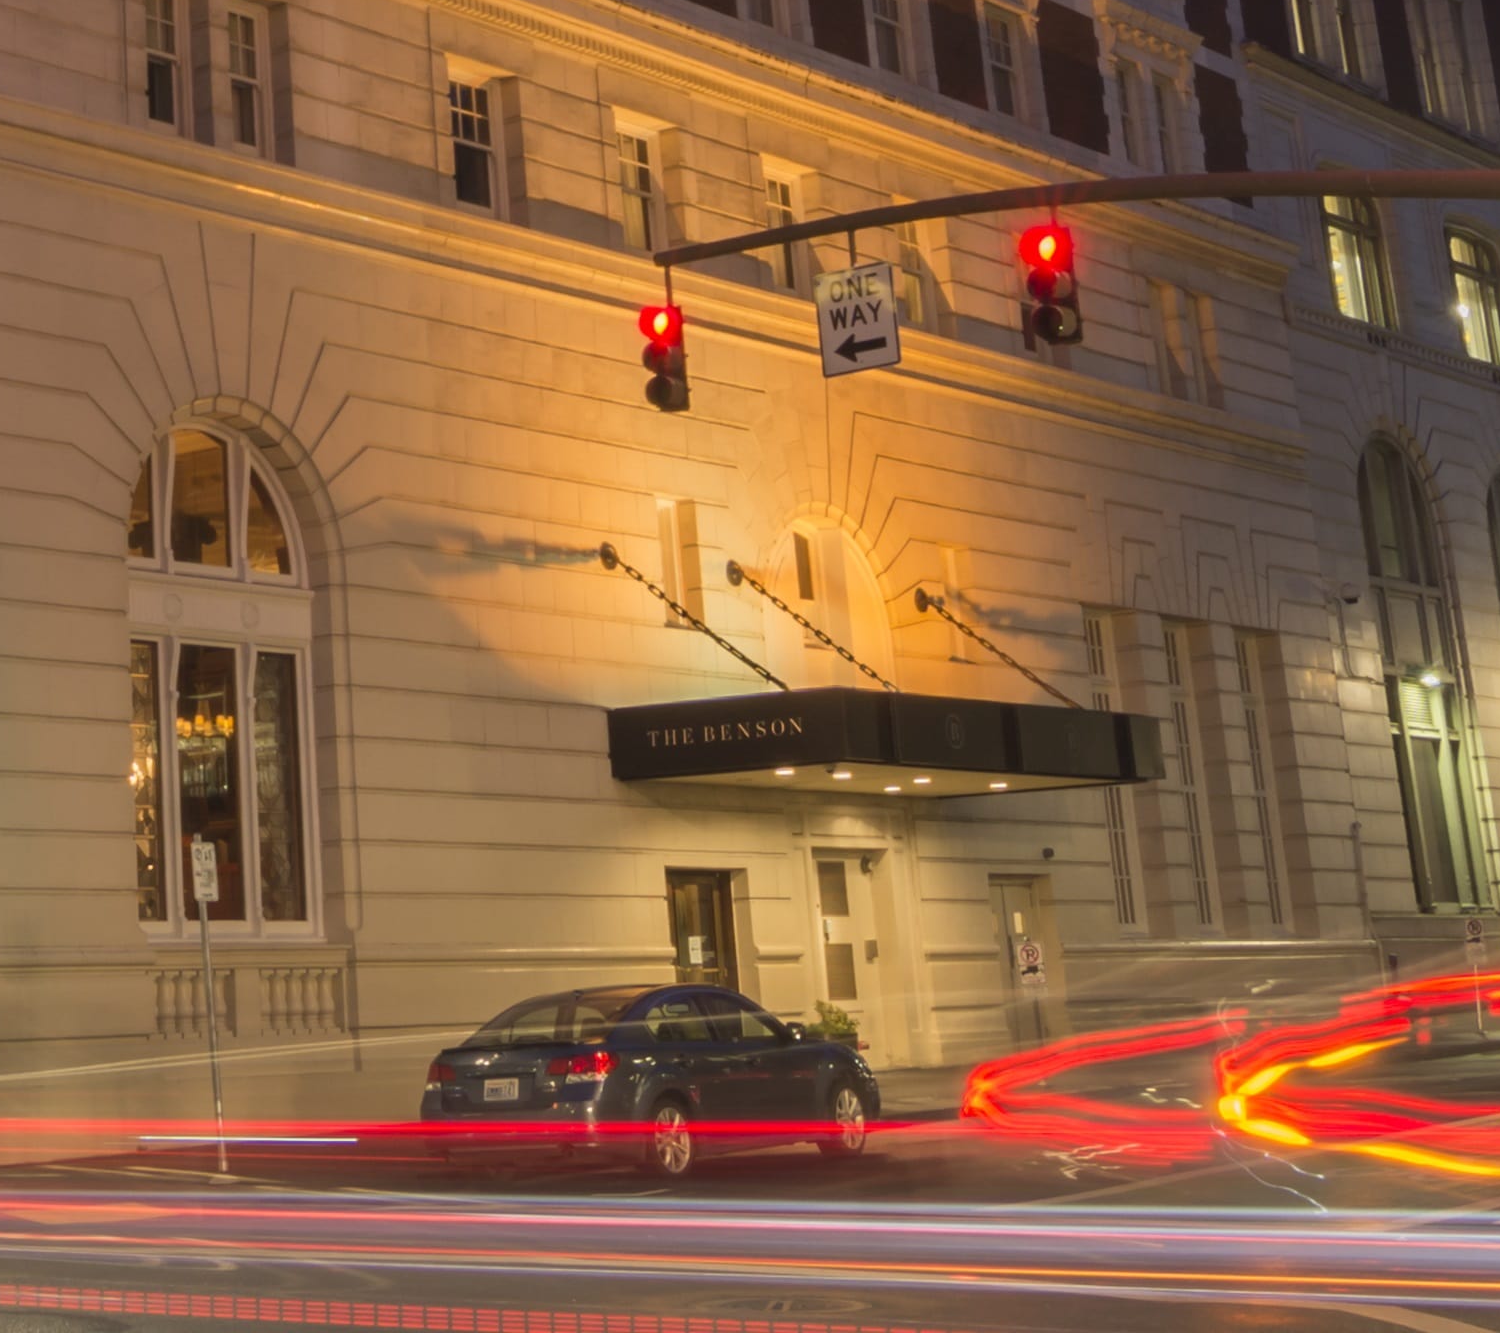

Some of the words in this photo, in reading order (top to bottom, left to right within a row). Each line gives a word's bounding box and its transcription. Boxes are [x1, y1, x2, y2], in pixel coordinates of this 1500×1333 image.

[830, 273, 878, 303] ONE
[829, 299, 882, 331] WAY
[648, 727, 694, 747] THE
[704, 717, 803, 742] BENSON
